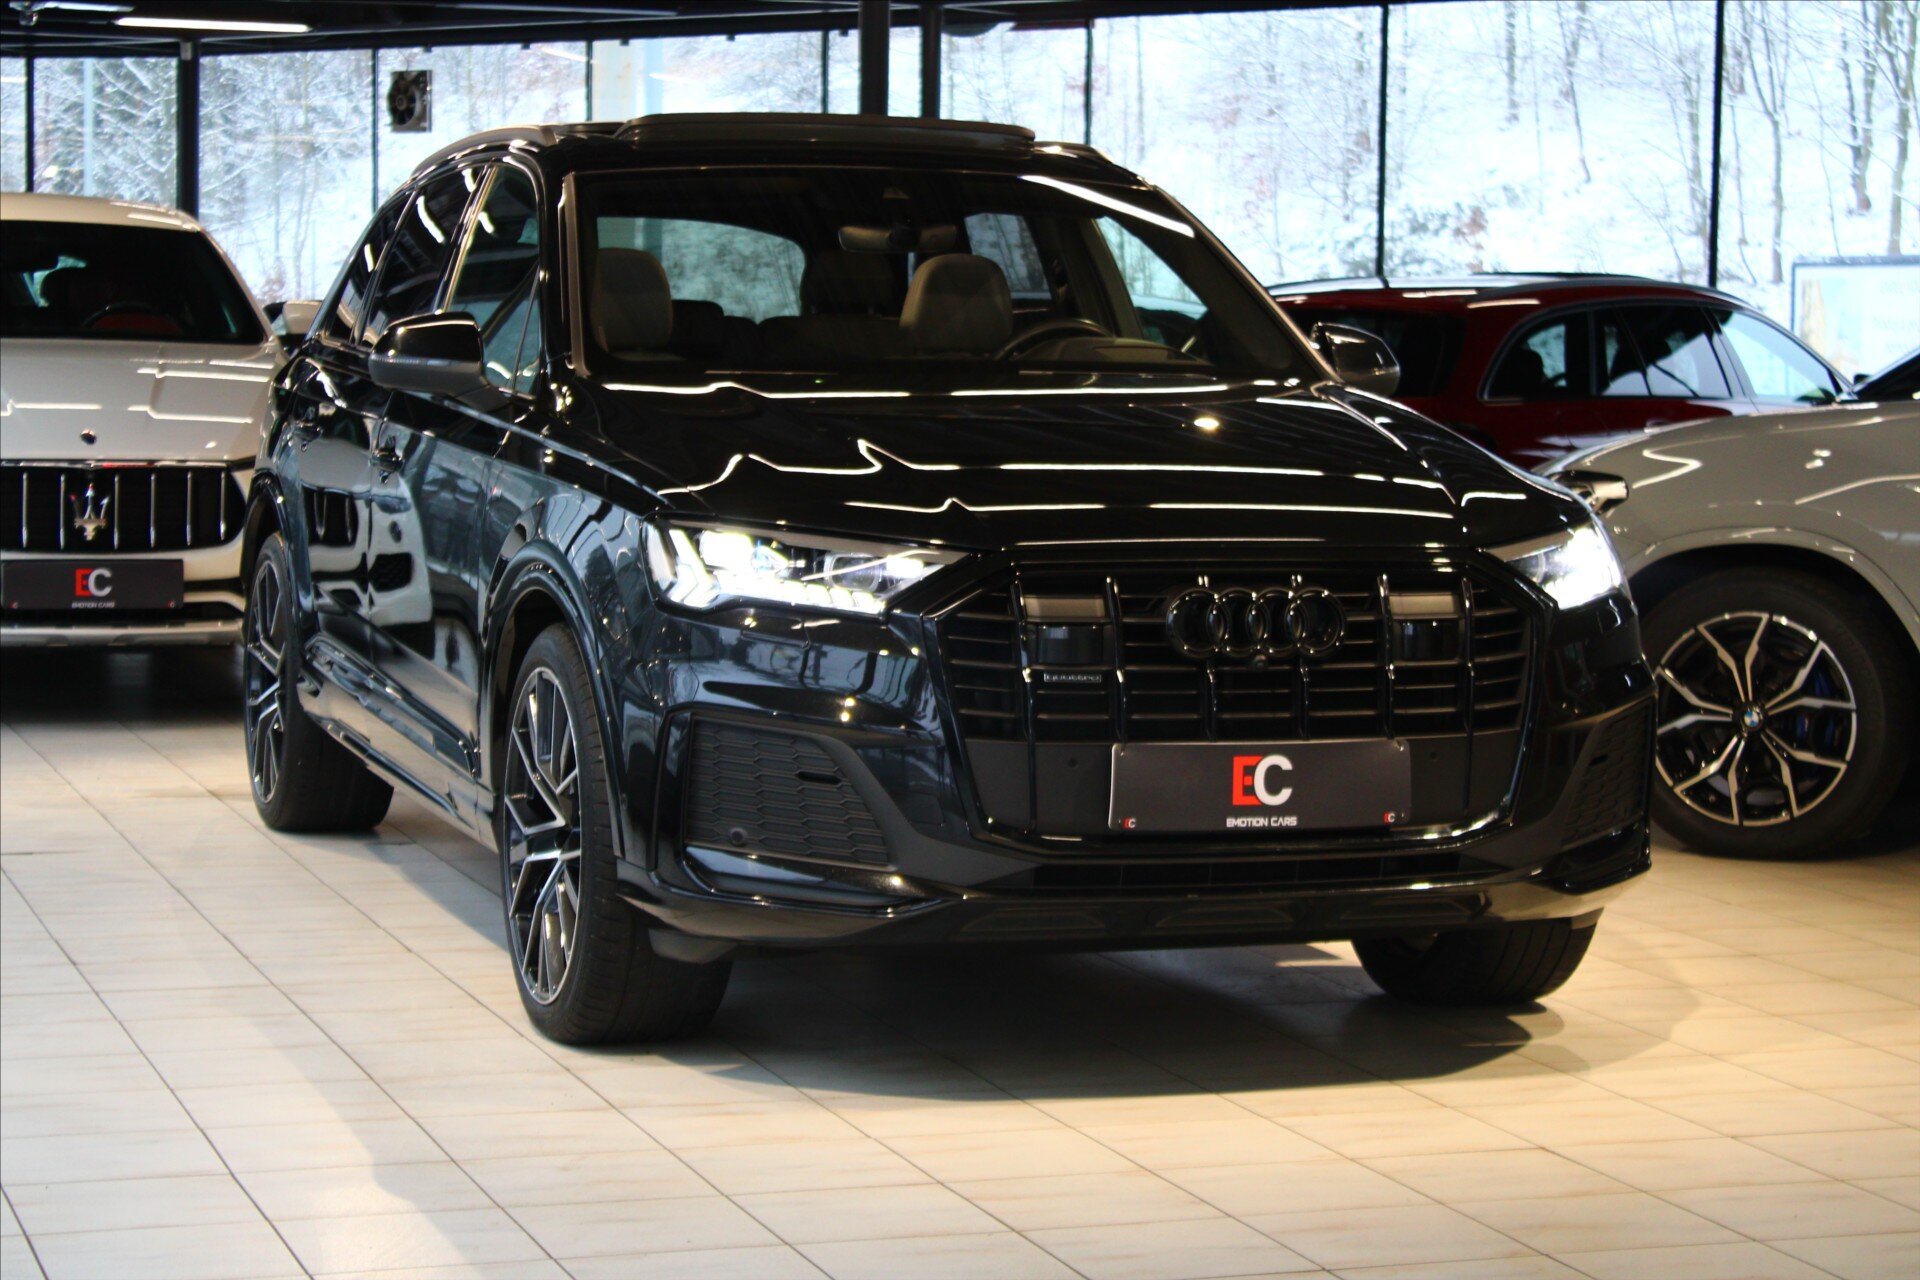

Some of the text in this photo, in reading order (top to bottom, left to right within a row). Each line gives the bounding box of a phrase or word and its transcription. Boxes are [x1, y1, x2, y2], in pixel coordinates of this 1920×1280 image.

[75, 568, 112, 597] EC
[1232, 755, 1293, 806] EC
[1226, 816, 1298, 828] EMOTION CARS
